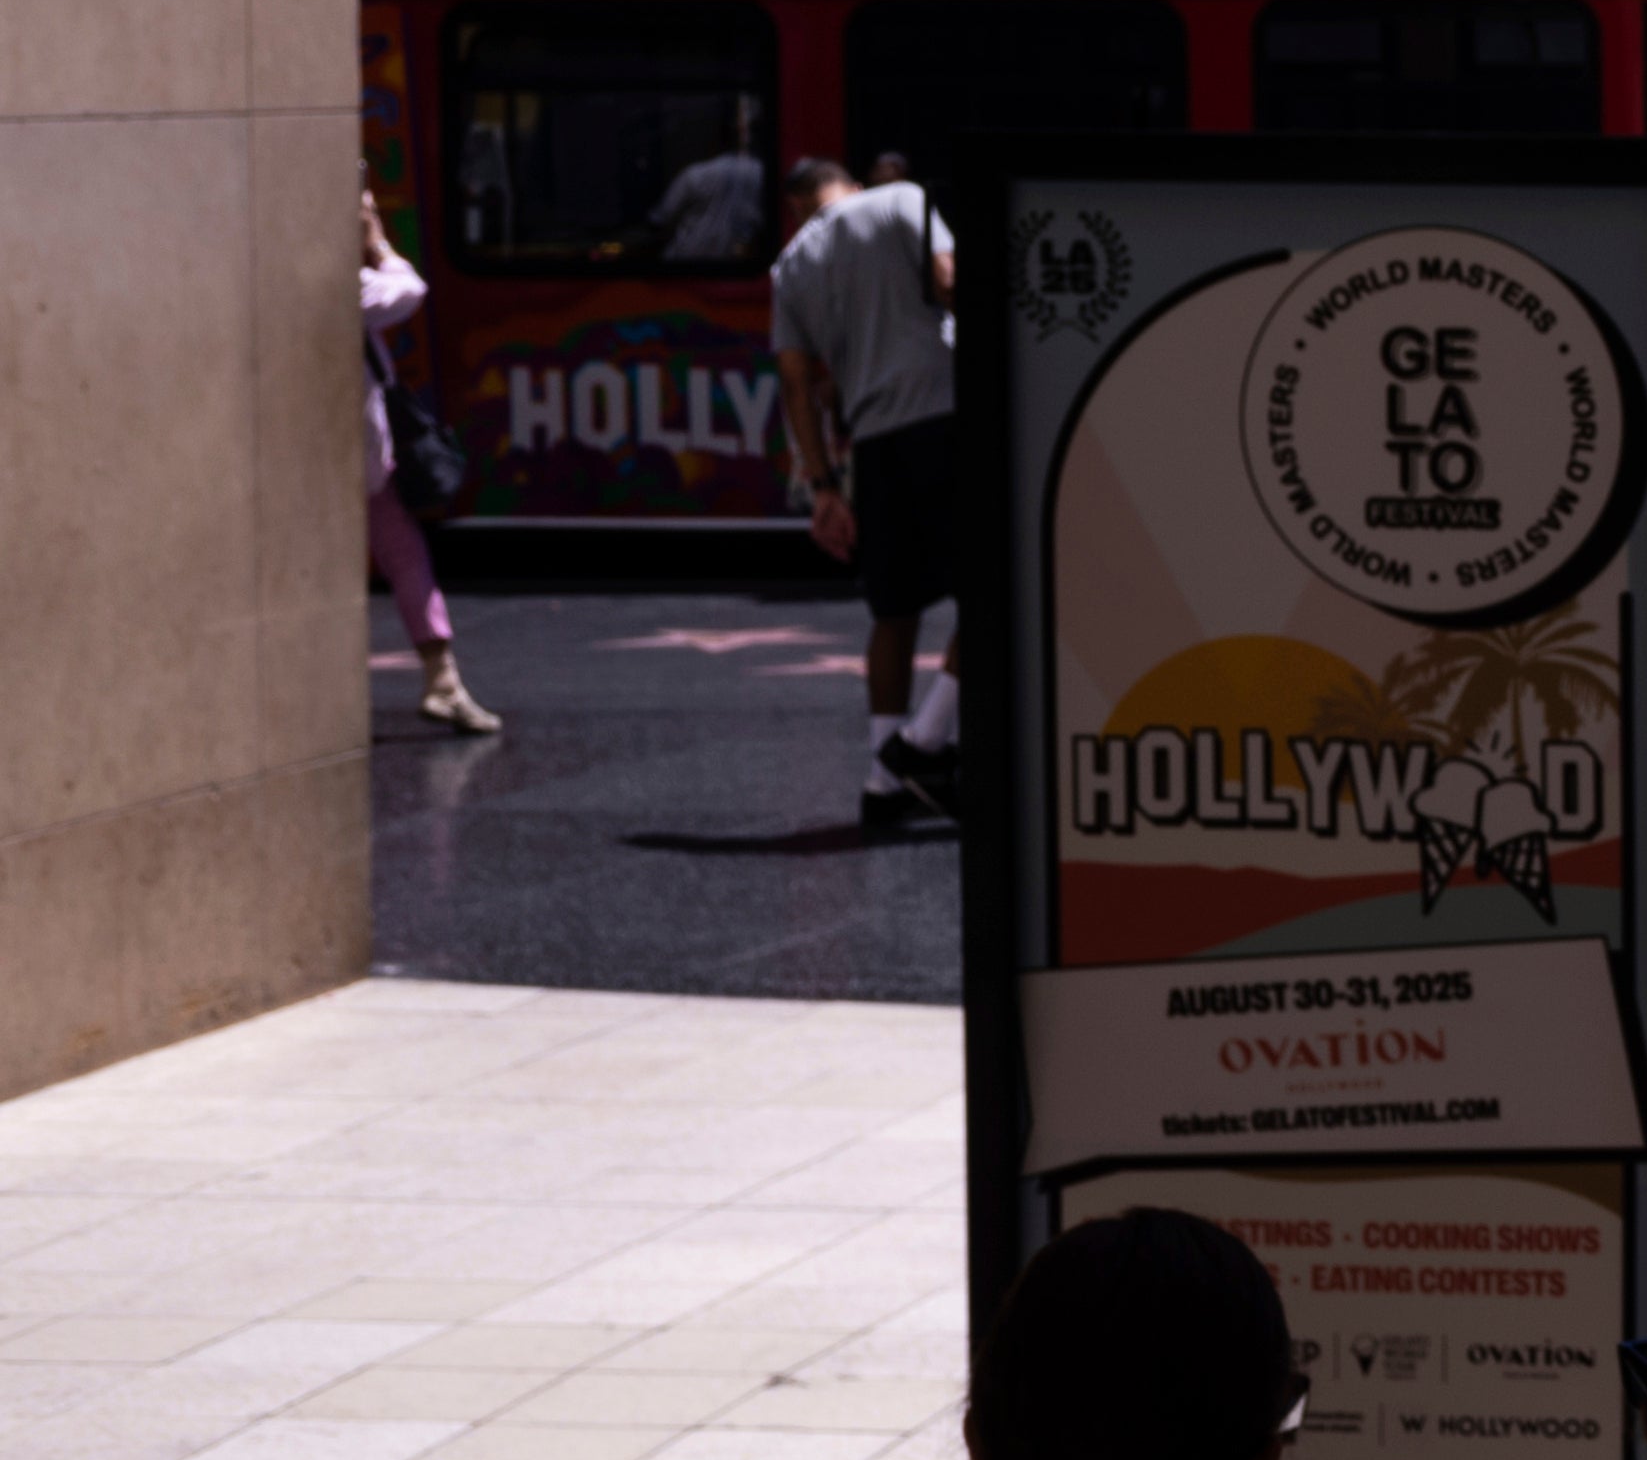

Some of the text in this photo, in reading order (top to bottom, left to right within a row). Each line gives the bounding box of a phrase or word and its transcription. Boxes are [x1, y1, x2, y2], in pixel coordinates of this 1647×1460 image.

[1039, 240, 1096, 268] LA
[1306, 257, 1558, 335] WORLD MASTERS
[1381, 326, 1478, 380] GE
[1386, 383, 1478, 439] LA
[1267, 363, 1413, 587] WORLD MASTERS
[1385, 441, 1482, 494] TO
[1455, 366, 1597, 587] WORLD MASTERS
[1366, 497, 1501, 529] FESTIVAL
[1072, 724, 1604, 840] HOLLYWD
[1166, 971, 1474, 1018] AUGUST 30-31, 2025
[1162, 1098, 1500, 1136] tickets: GELATOFESTIVAL.COM
[1362, 1221, 1491, 1252] COOKING
[1498, 1226, 1600, 1255] SHOWS
[1311, 1264, 1412, 1293] EATING
[1418, 1268, 1567, 1298] CONTESTS
[1400, 1415, 1600, 1440] W HOLLYWOOD
